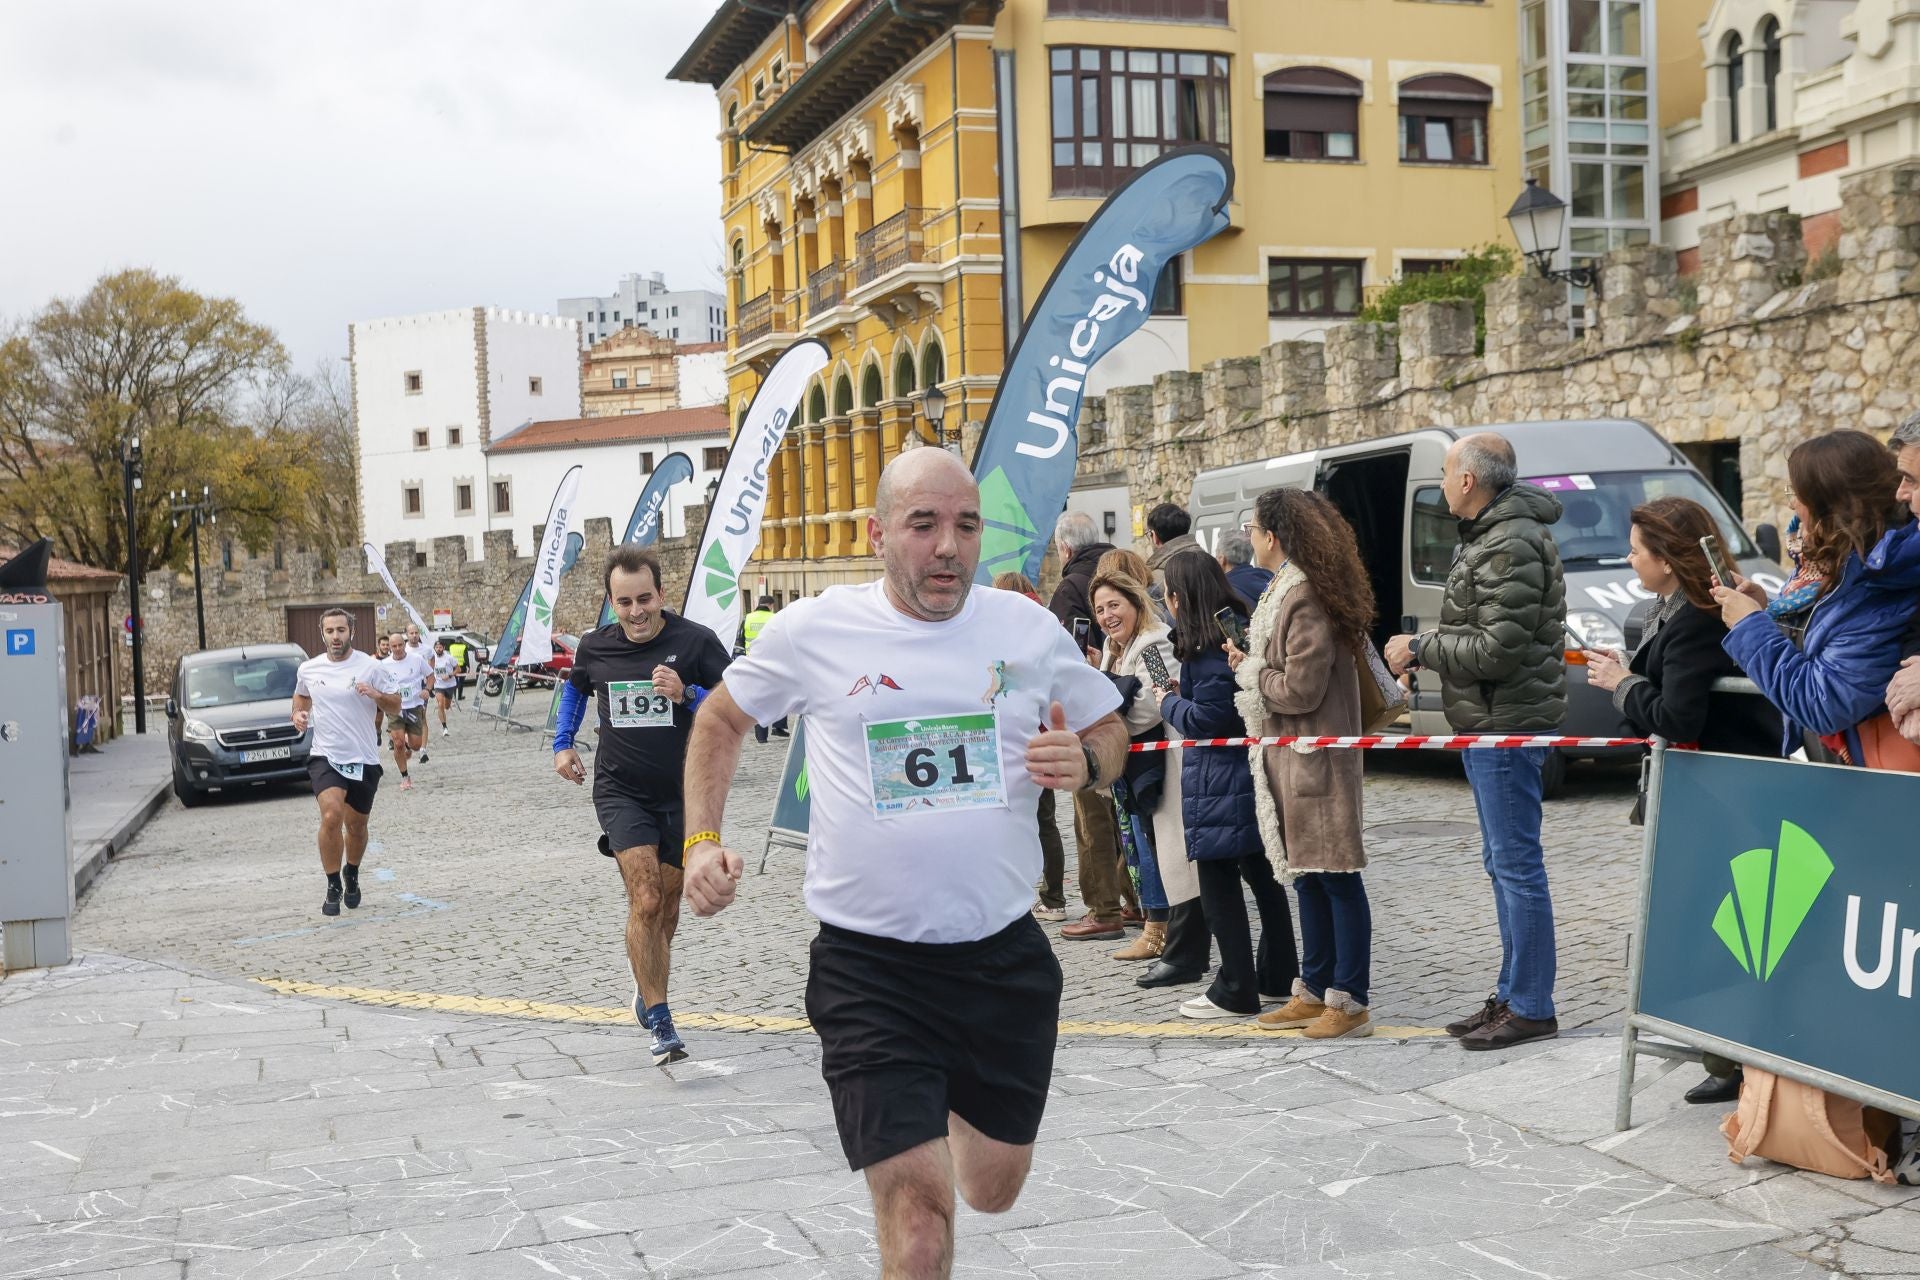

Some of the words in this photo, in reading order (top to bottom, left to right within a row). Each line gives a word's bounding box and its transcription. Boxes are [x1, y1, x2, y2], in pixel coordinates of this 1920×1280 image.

[1015, 243, 1147, 459] Unicaja
[724, 407, 788, 536] Unicaja
[543, 507, 568, 586] Unicaja
[14, 633, 29, 651] P
[618, 695, 669, 715] 193
[905, 744, 975, 788] 61
